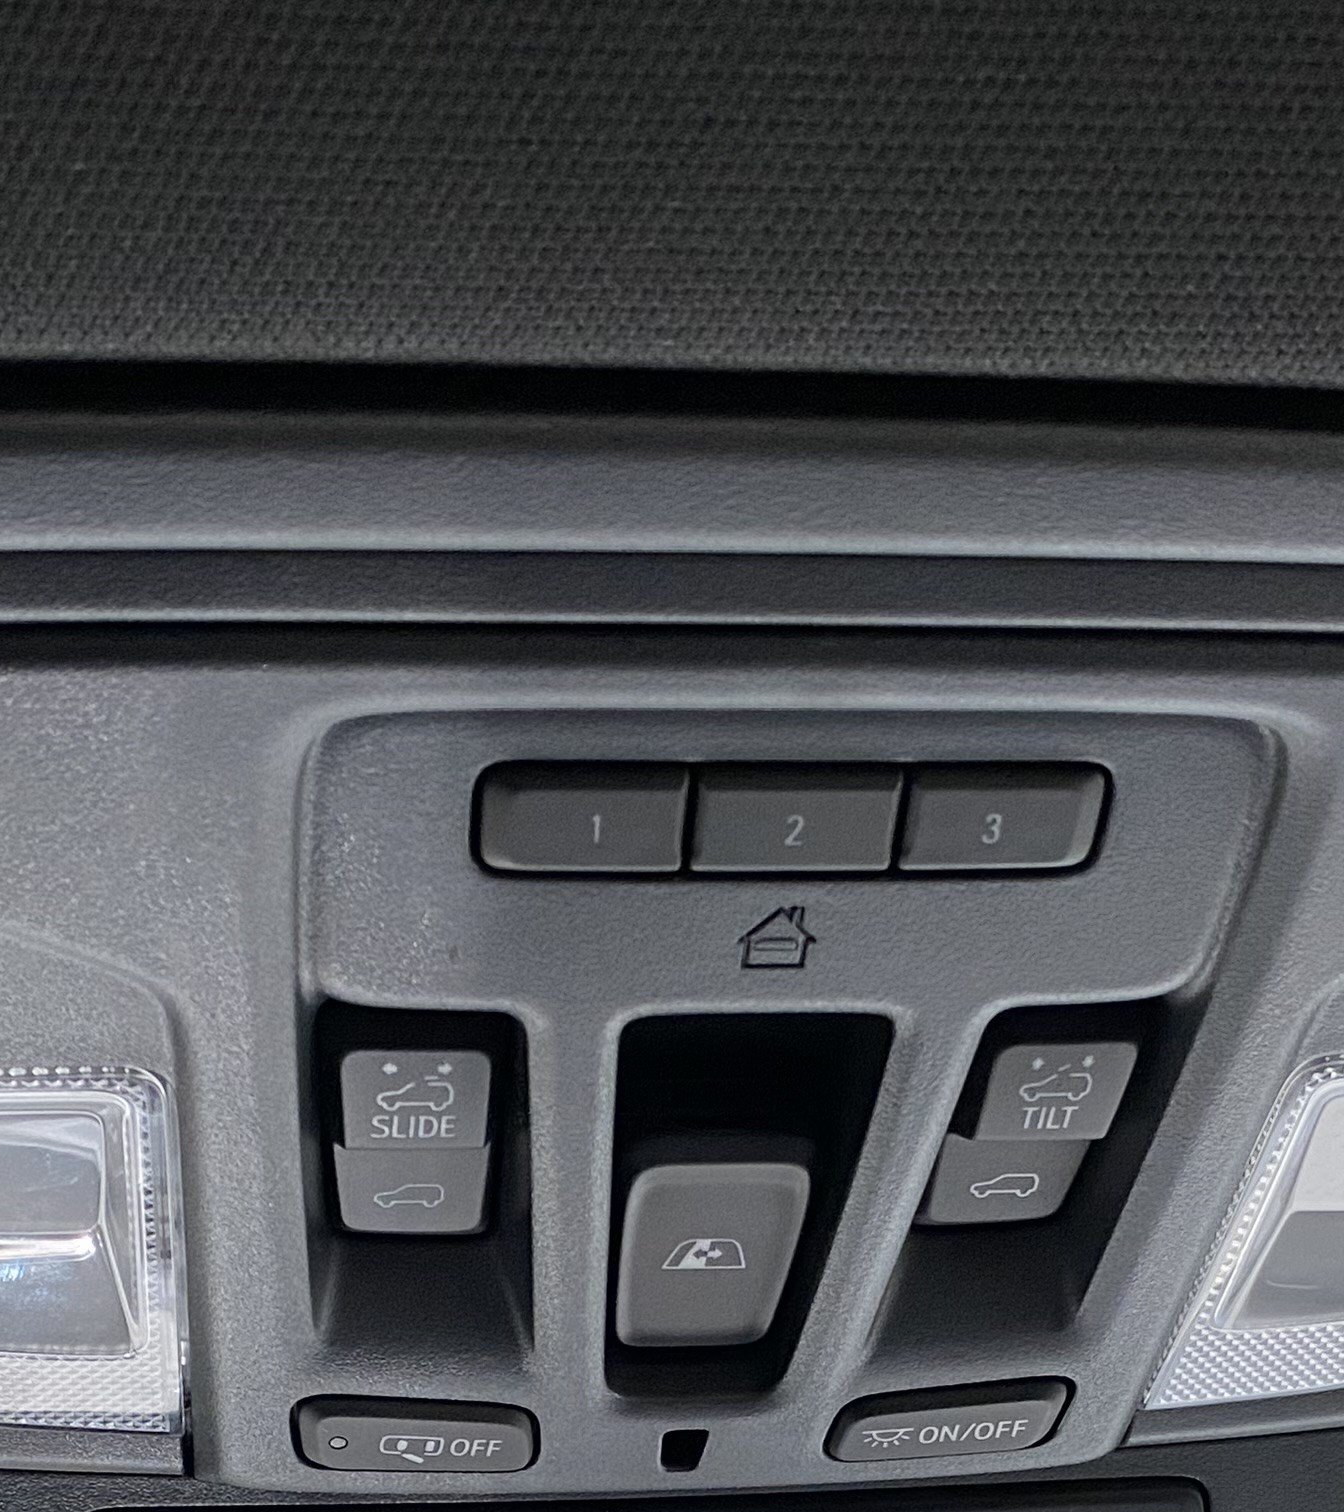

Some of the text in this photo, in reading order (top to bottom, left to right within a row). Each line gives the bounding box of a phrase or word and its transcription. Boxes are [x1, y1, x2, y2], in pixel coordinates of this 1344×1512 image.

[591, 814, 602, 844] 1
[784, 814, 806, 846] 2
[980, 813, 1003, 845] 3
[370, 1114, 456, 1139] SLIDE
[1021, 1105, 1080, 1130] TILT
[917, 1418, 1029, 1446] ON/OFF
[450, 1437, 504, 1459] OFF
